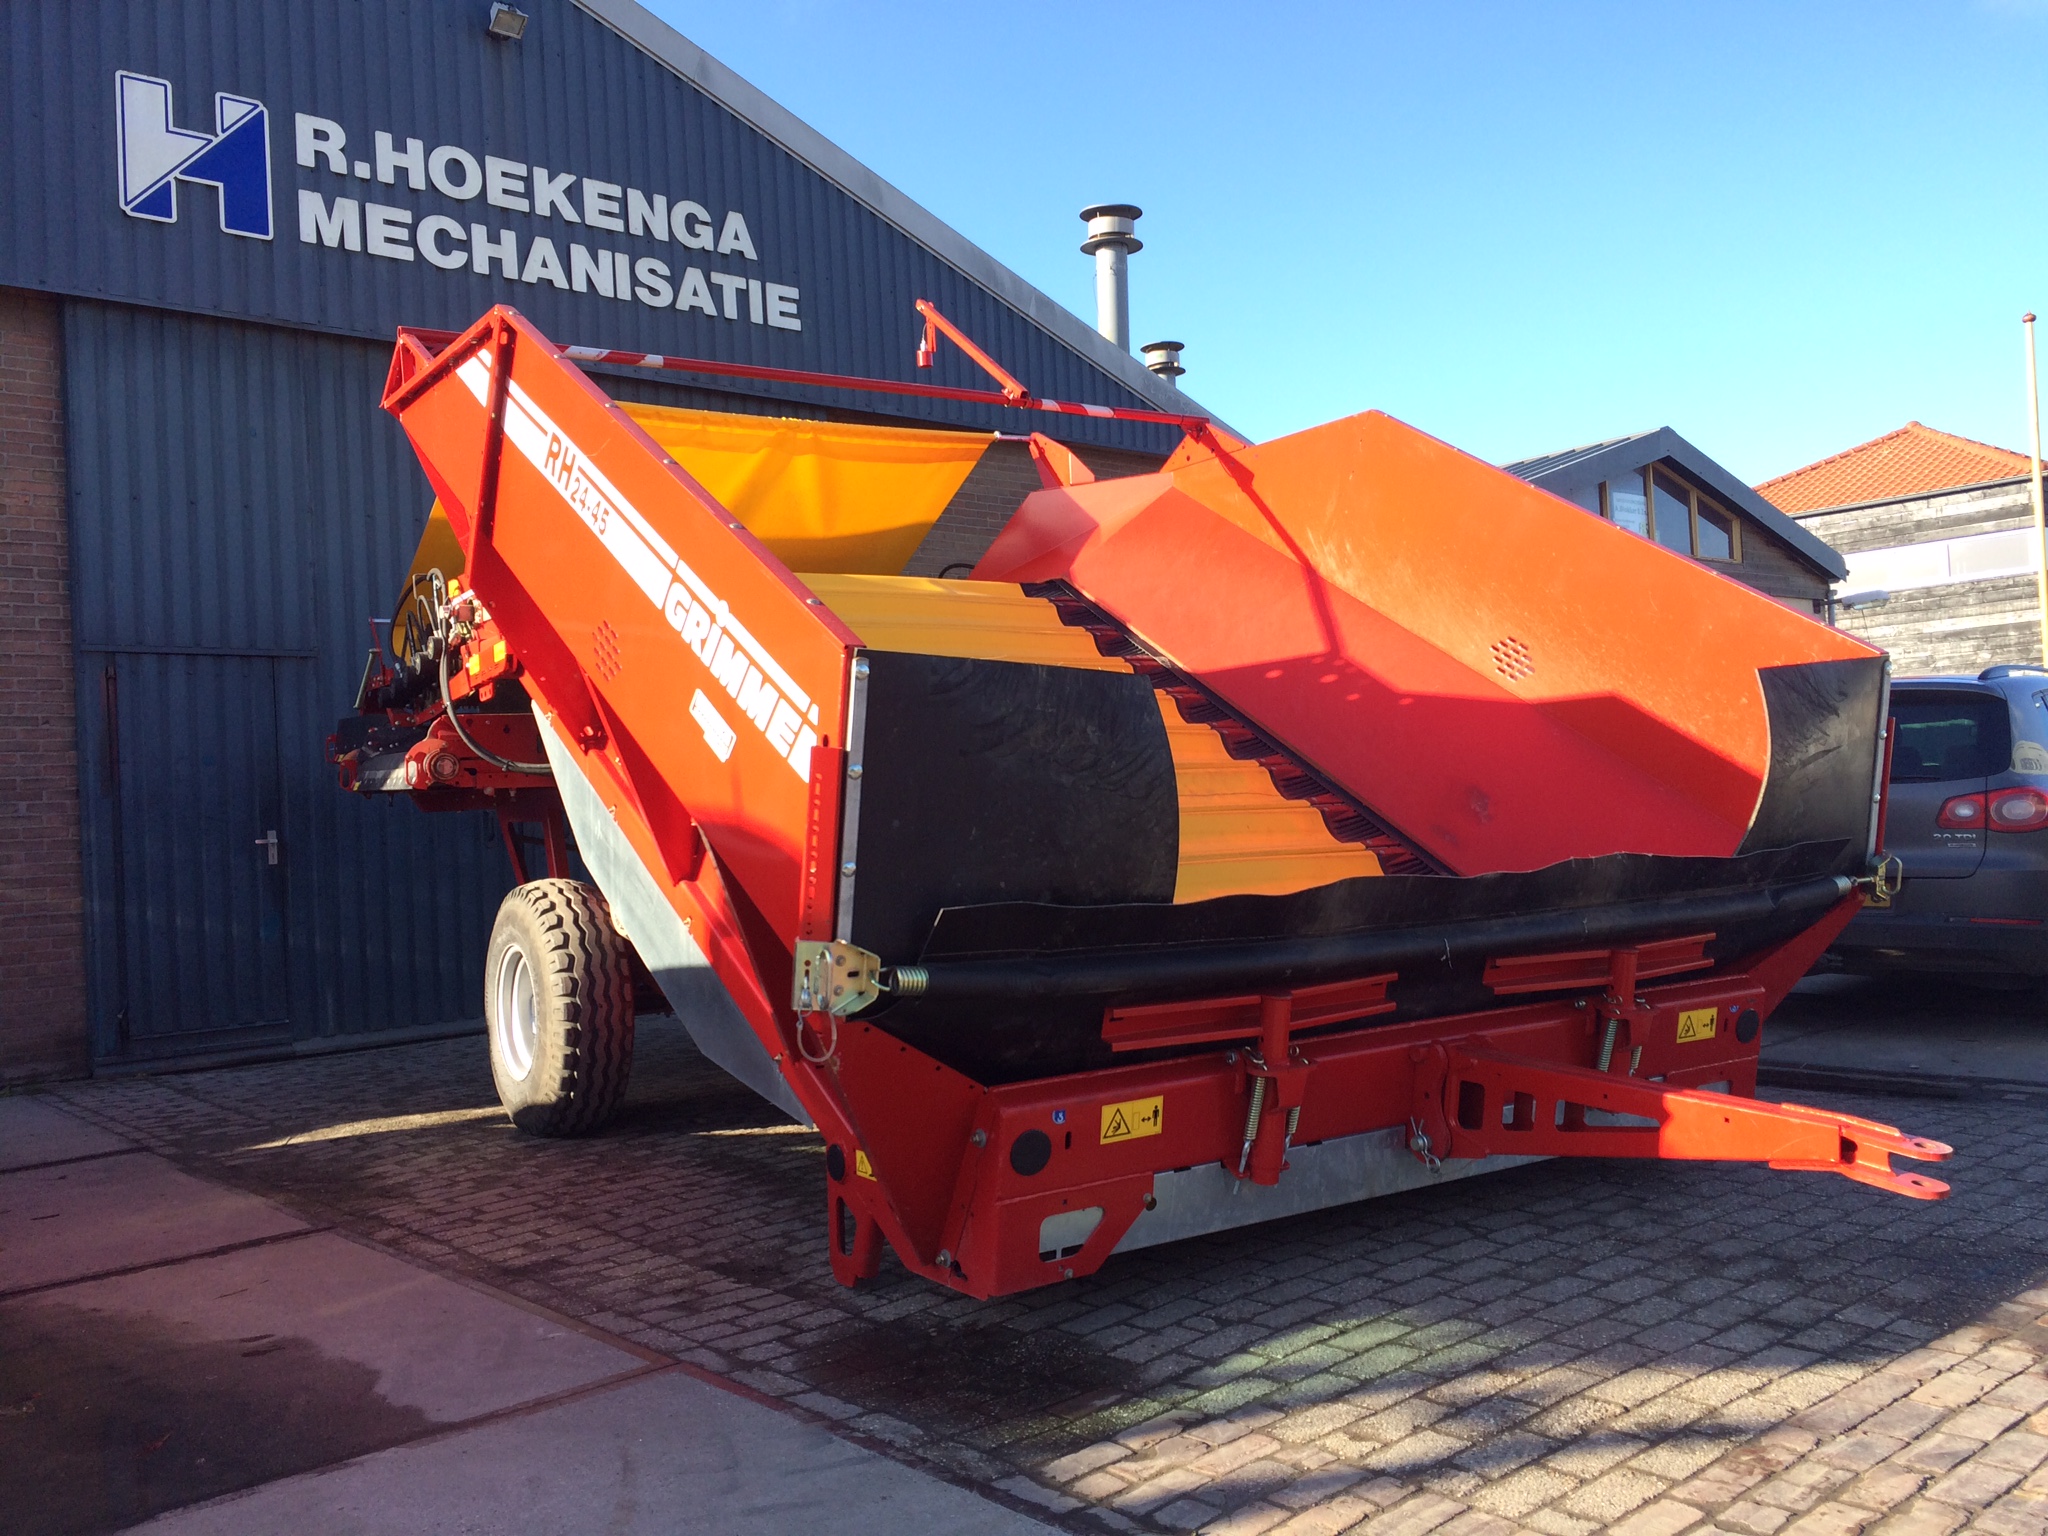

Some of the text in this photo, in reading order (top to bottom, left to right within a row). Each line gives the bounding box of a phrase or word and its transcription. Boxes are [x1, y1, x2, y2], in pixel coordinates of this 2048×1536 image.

[294, 112, 758, 261] R.HOEKENGA
[298, 188, 802, 332] MECHANISATIE
[664, 580, 804, 759] GRIMME
